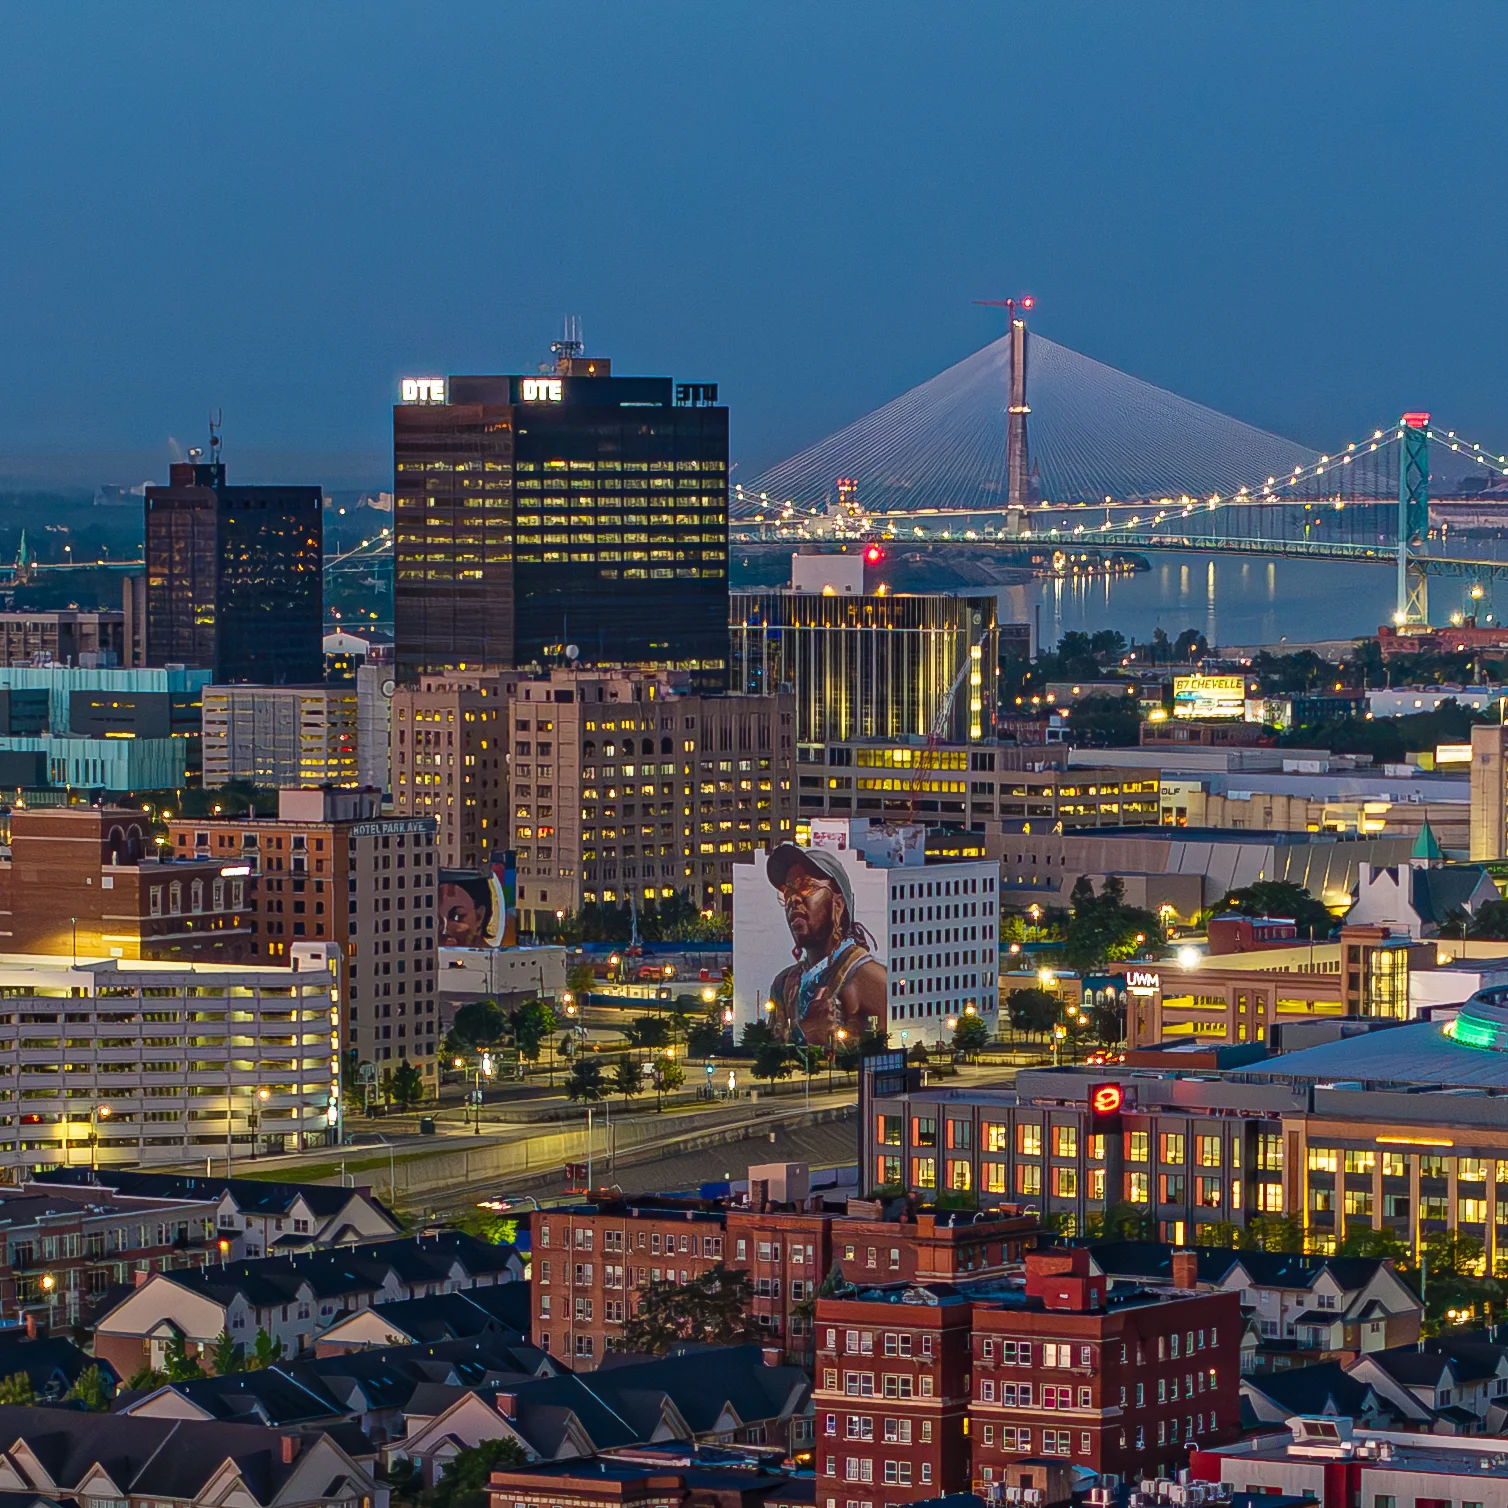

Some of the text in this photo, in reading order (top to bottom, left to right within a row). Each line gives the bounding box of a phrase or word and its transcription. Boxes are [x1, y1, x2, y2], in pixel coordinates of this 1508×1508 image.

[402, 379, 445, 401] DTE
[523, 379, 562, 401] DTE
[1191, 679, 1243, 689] CHEVELLE
[353, 824, 380, 835] HOTEL
[382, 822, 405, 833] PARK
[1126, 971, 1159, 987] UWM
